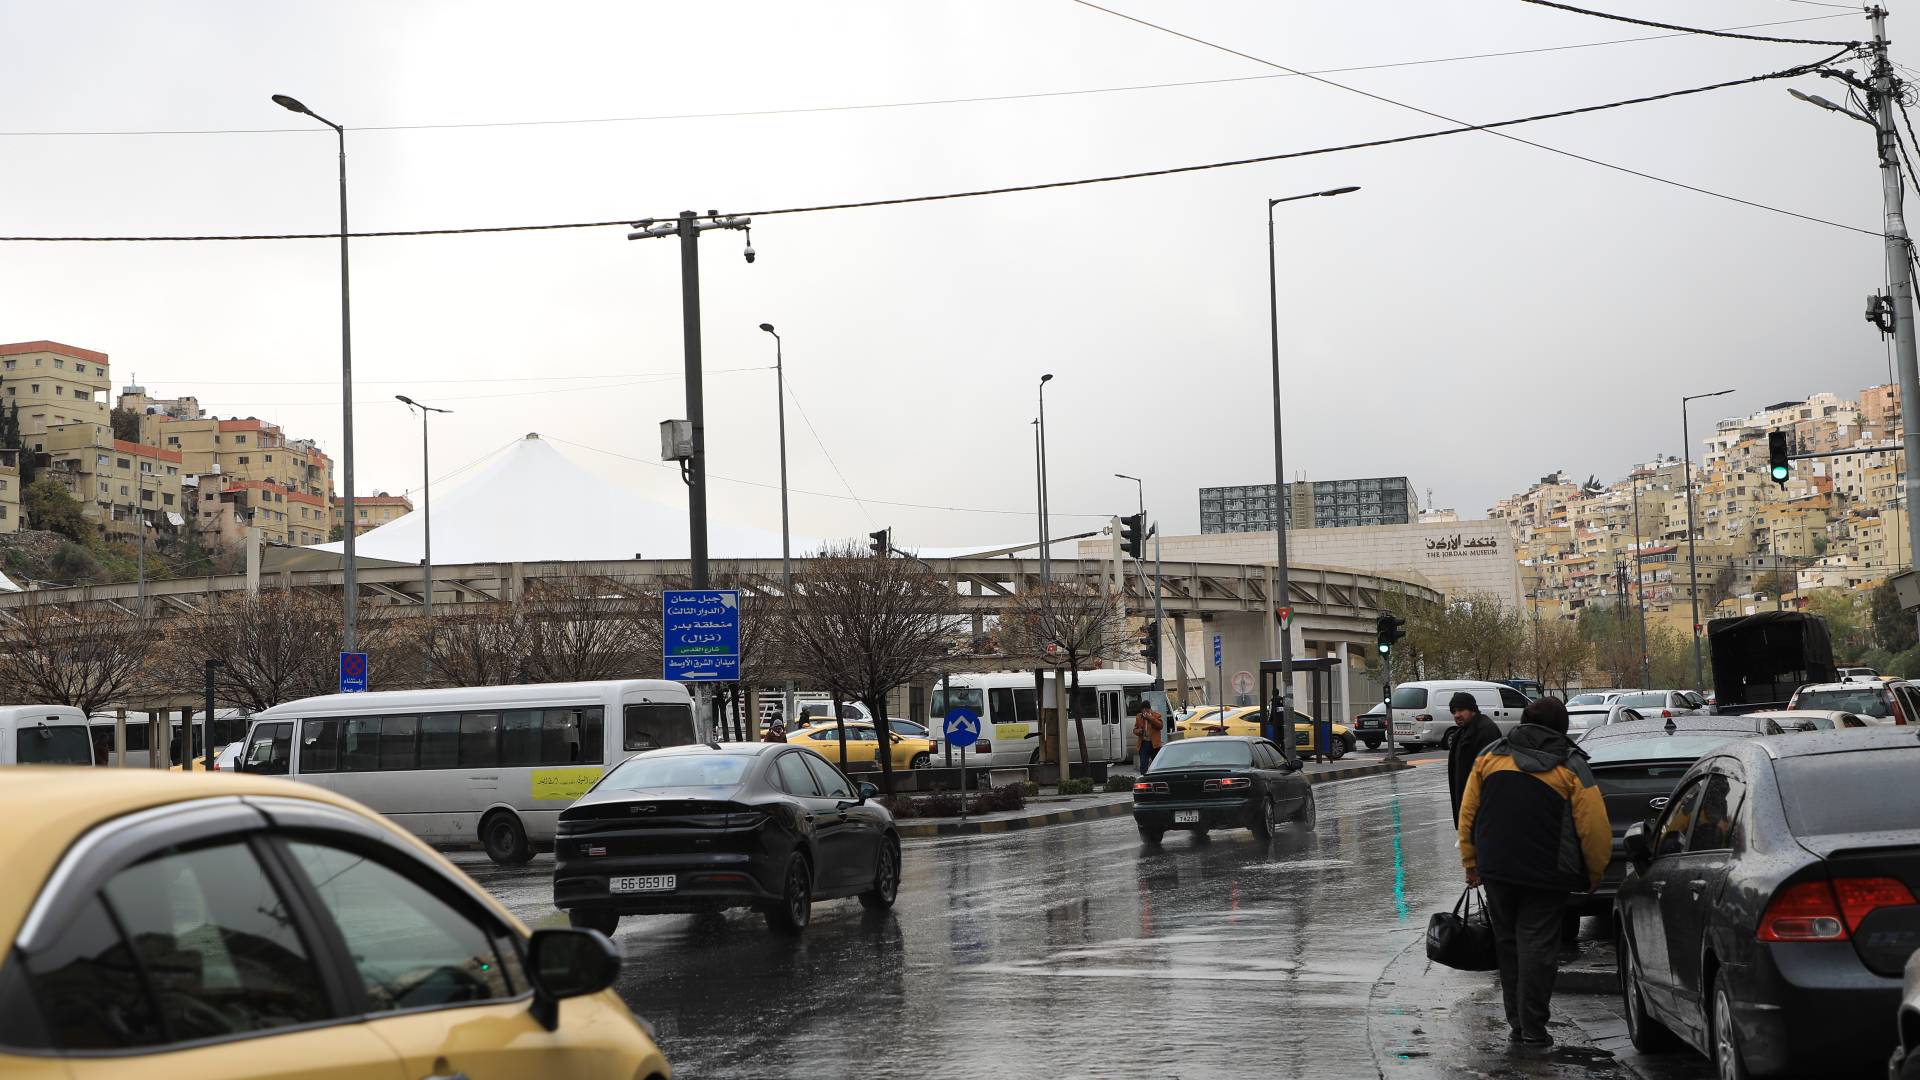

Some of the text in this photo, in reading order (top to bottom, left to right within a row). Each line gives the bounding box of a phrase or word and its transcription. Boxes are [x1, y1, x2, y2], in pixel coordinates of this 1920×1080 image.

[1442, 550, 1467, 558] JORDAN
[671, 594, 720, 604] جبل عمان
[670, 623, 692, 631] بدر
[693, 659, 713, 668] الشرق
[714, 658, 736, 667] ميدان
[630, 805, 656, 813] BYD
[621, 876, 674, 889] 66-85918
